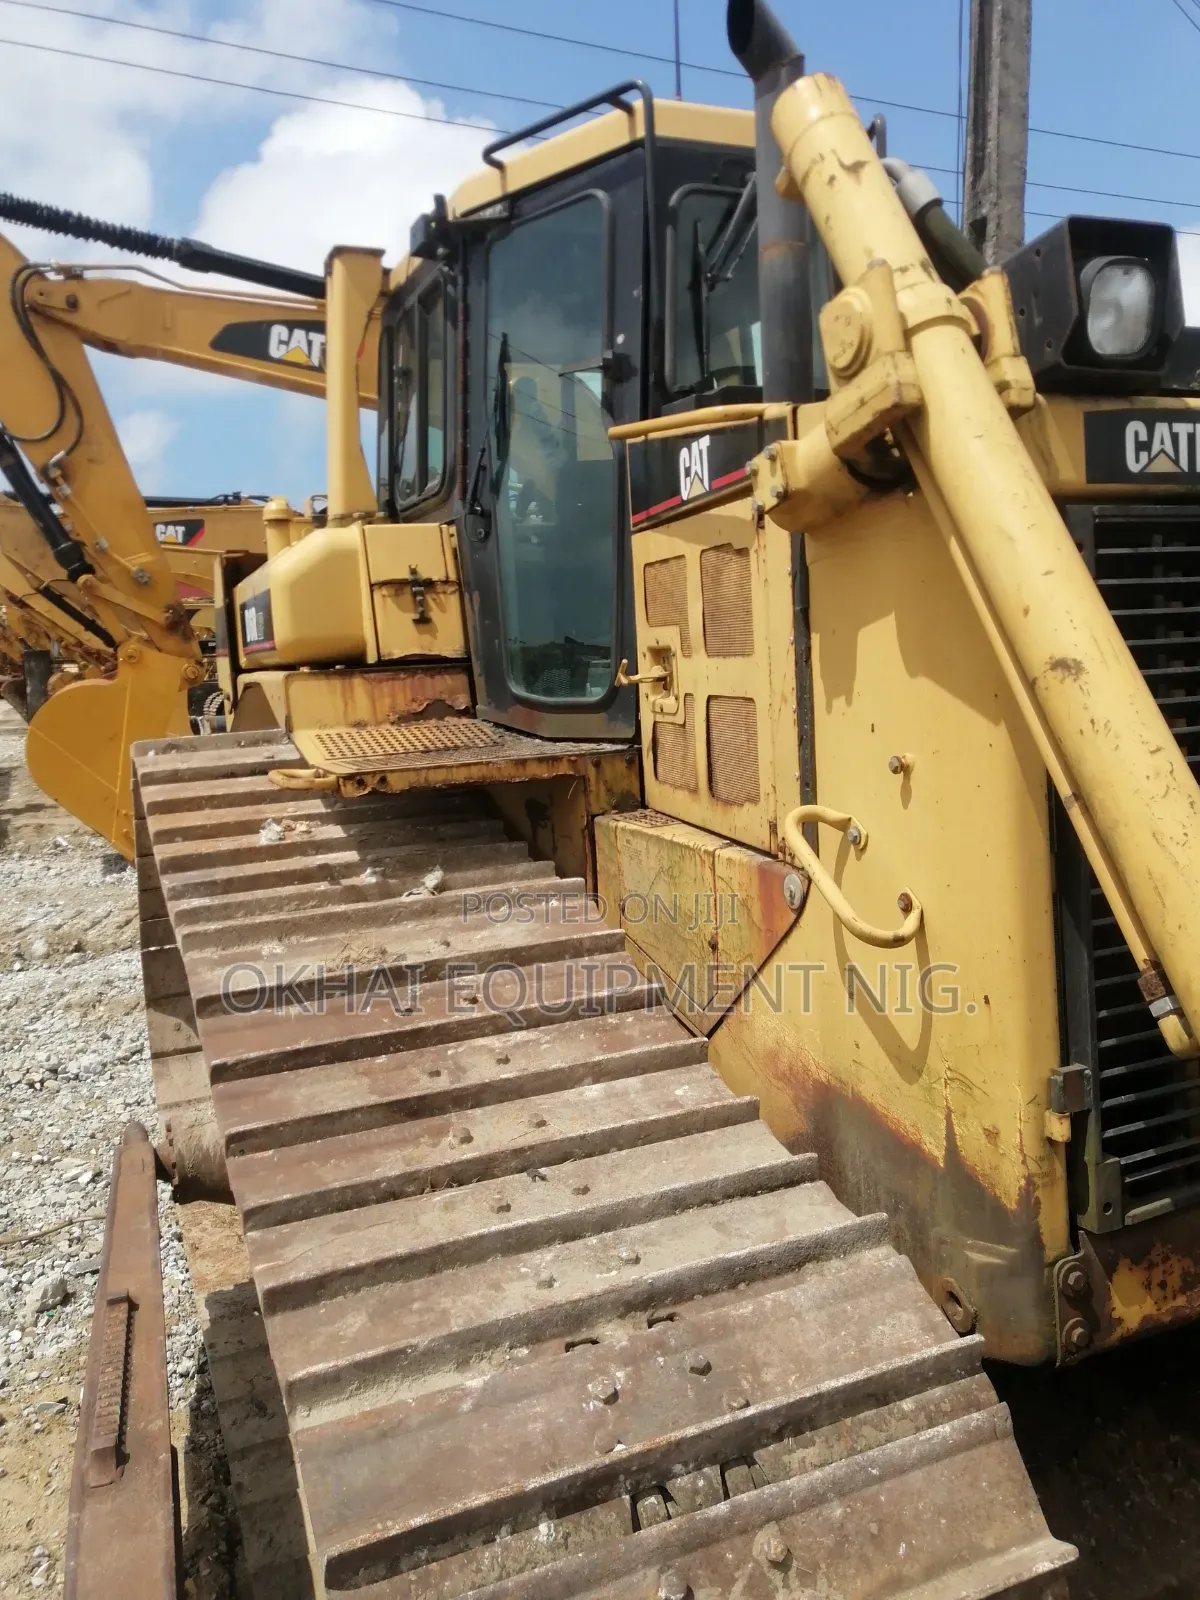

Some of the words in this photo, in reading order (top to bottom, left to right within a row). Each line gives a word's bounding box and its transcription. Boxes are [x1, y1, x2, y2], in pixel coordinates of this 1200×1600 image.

[268, 324, 326, 367] CAT
[679, 434, 710, 501] CAT
[155, 524, 186, 543] CAT
